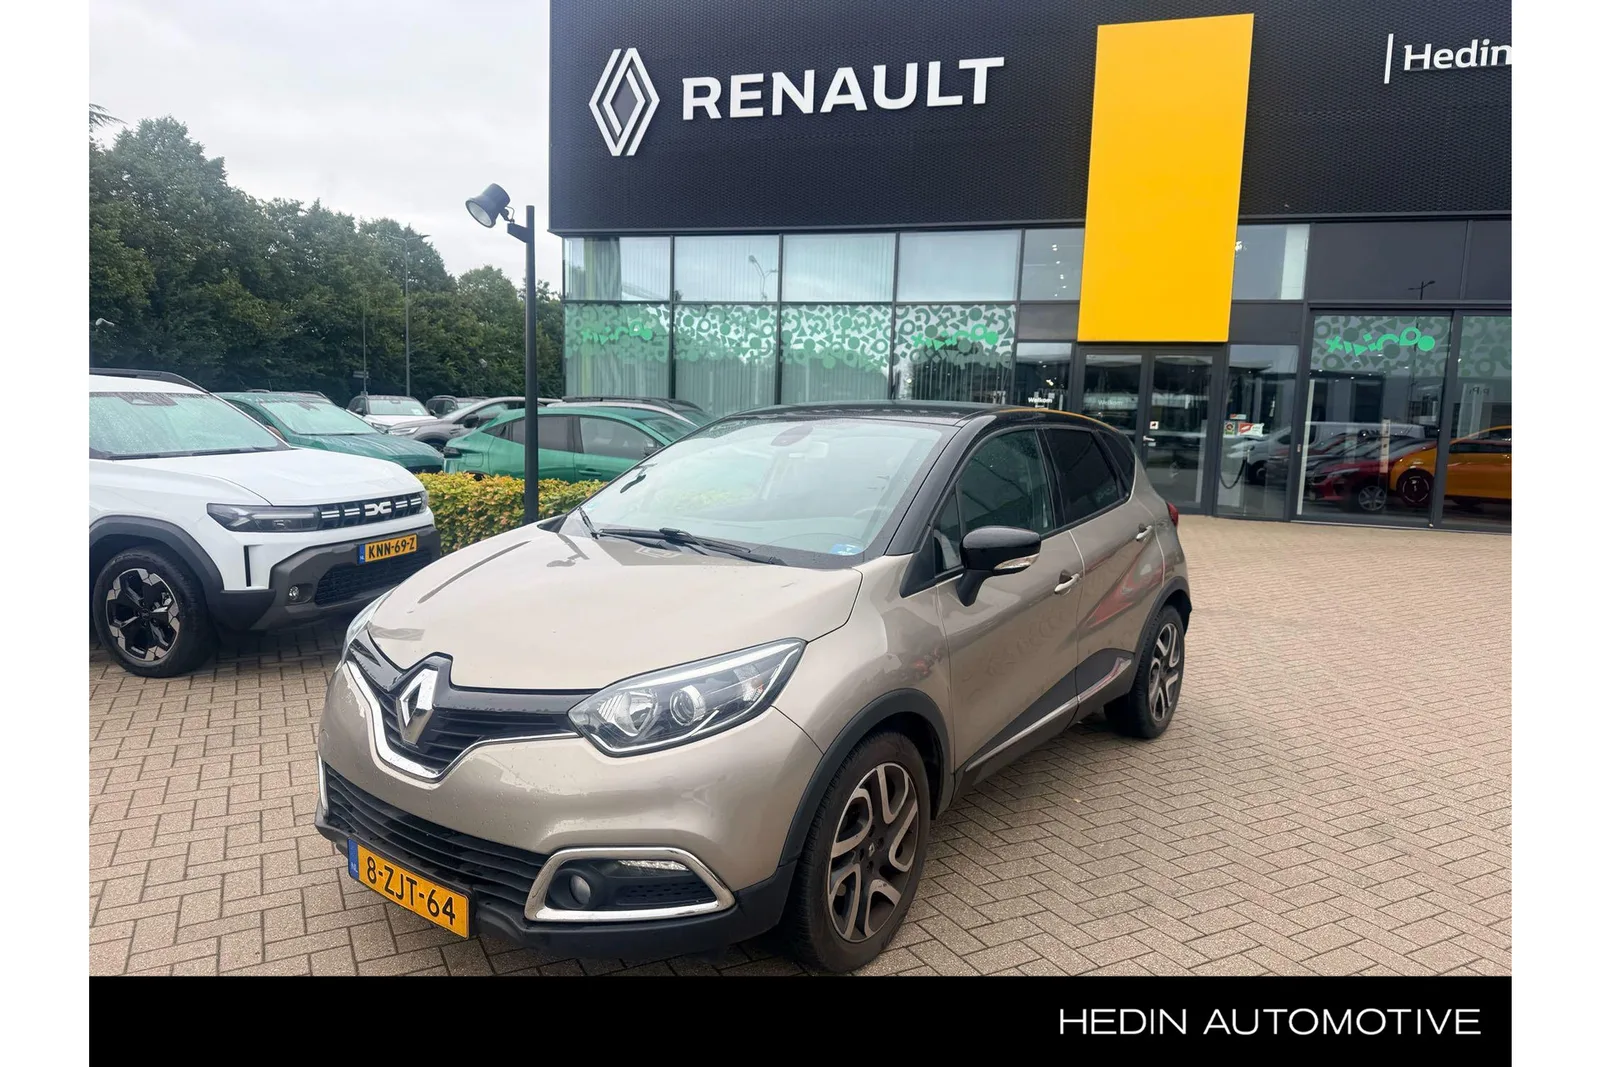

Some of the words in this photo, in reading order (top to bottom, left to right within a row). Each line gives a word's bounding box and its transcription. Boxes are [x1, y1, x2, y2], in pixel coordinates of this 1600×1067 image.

[1403, 38, 1512, 71] Hedin
[682, 56, 1005, 120] RENAULT
[368, 537, 415, 559] KNN-69-Z
[366, 856, 456, 926] 8-ZJT-64
